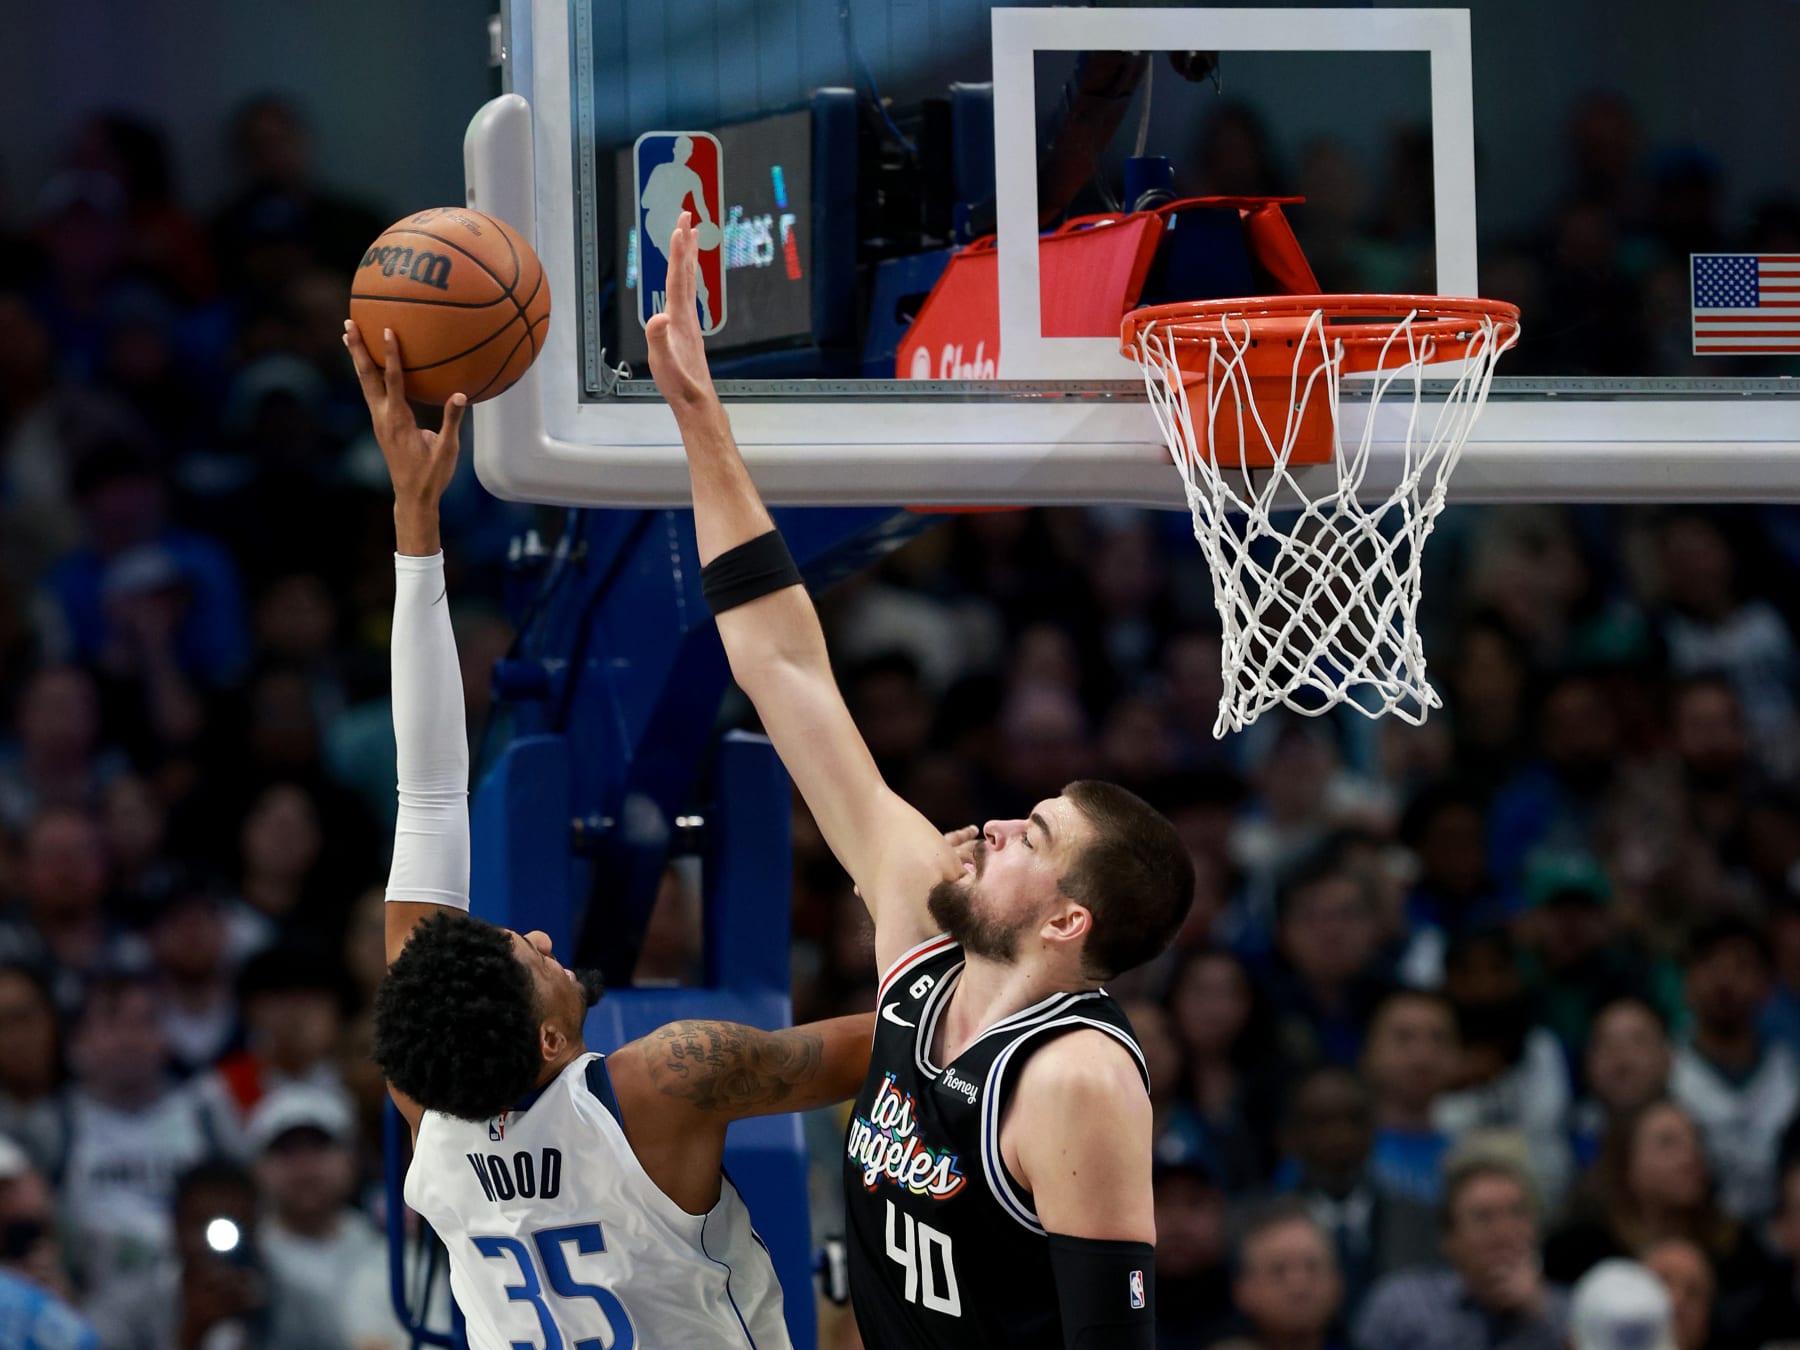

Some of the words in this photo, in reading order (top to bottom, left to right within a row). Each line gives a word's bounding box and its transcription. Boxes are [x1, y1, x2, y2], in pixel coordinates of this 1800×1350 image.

[909, 974, 935, 1000] 6
[942, 1068, 979, 1105] honey
[466, 1147, 563, 1203] WOOD
[886, 1199, 962, 1318] 40
